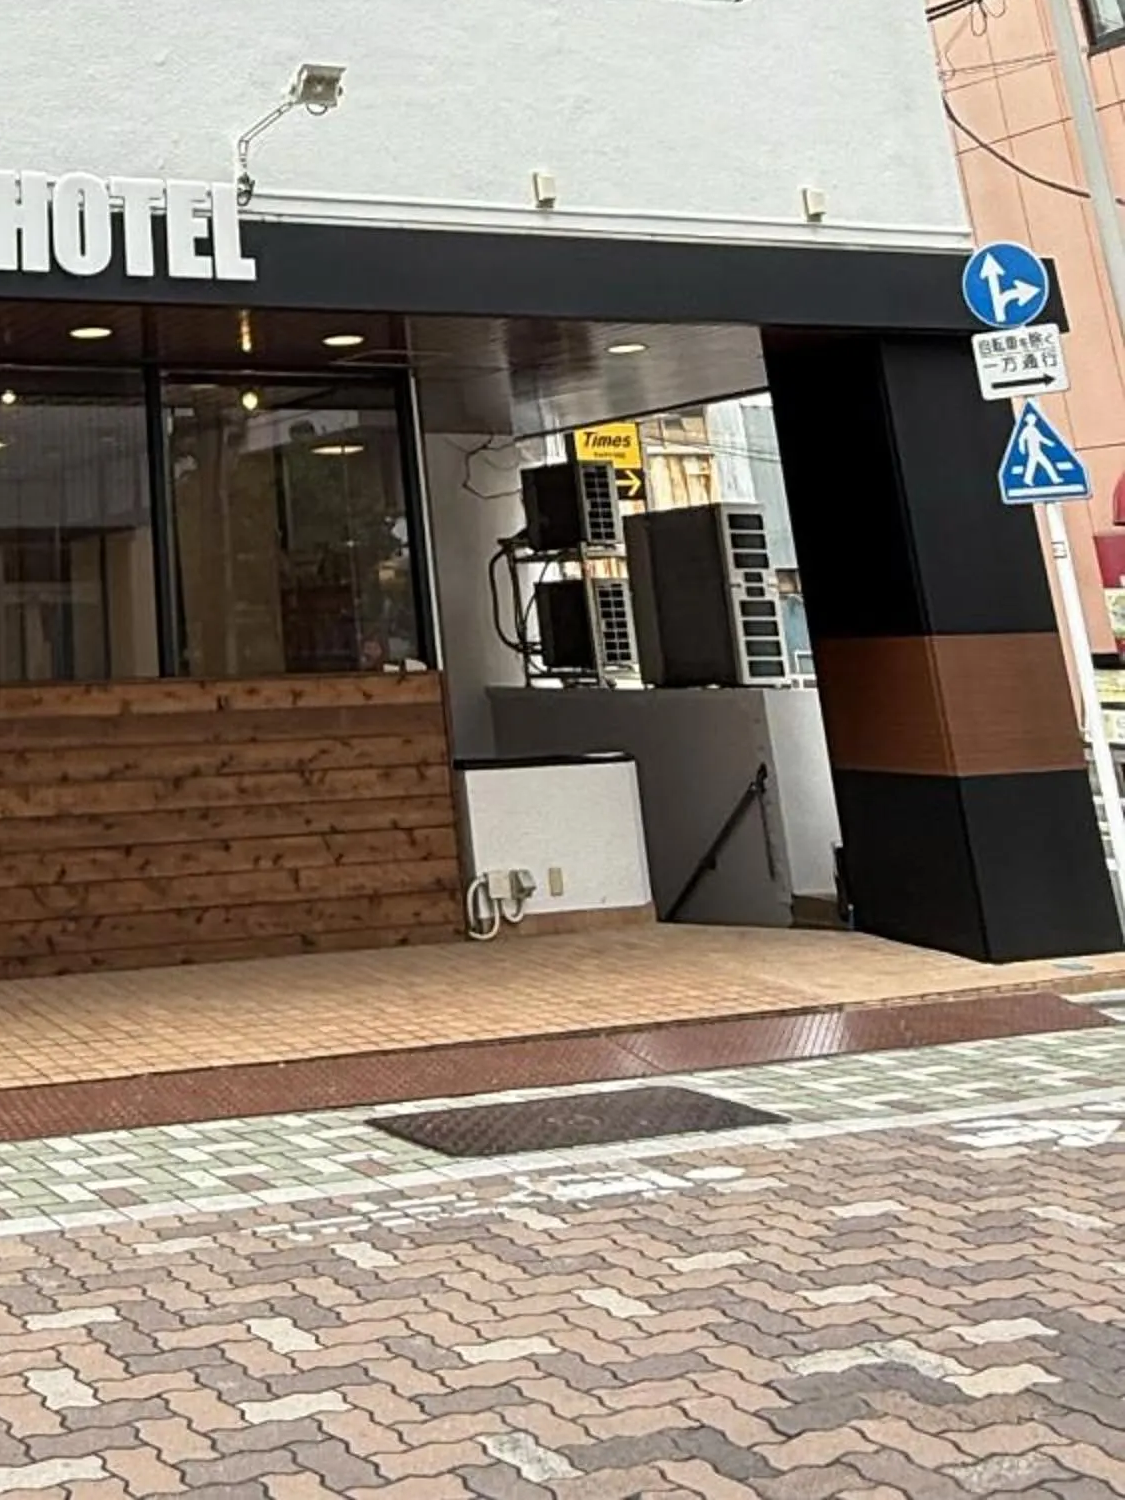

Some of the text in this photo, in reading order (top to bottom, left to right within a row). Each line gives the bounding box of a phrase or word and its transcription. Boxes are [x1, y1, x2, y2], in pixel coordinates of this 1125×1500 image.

[978, 331, 1053, 358] 自転車を除く
[983, 351, 1058, 373] 一方通行
[583, 431, 632, 449] Times
